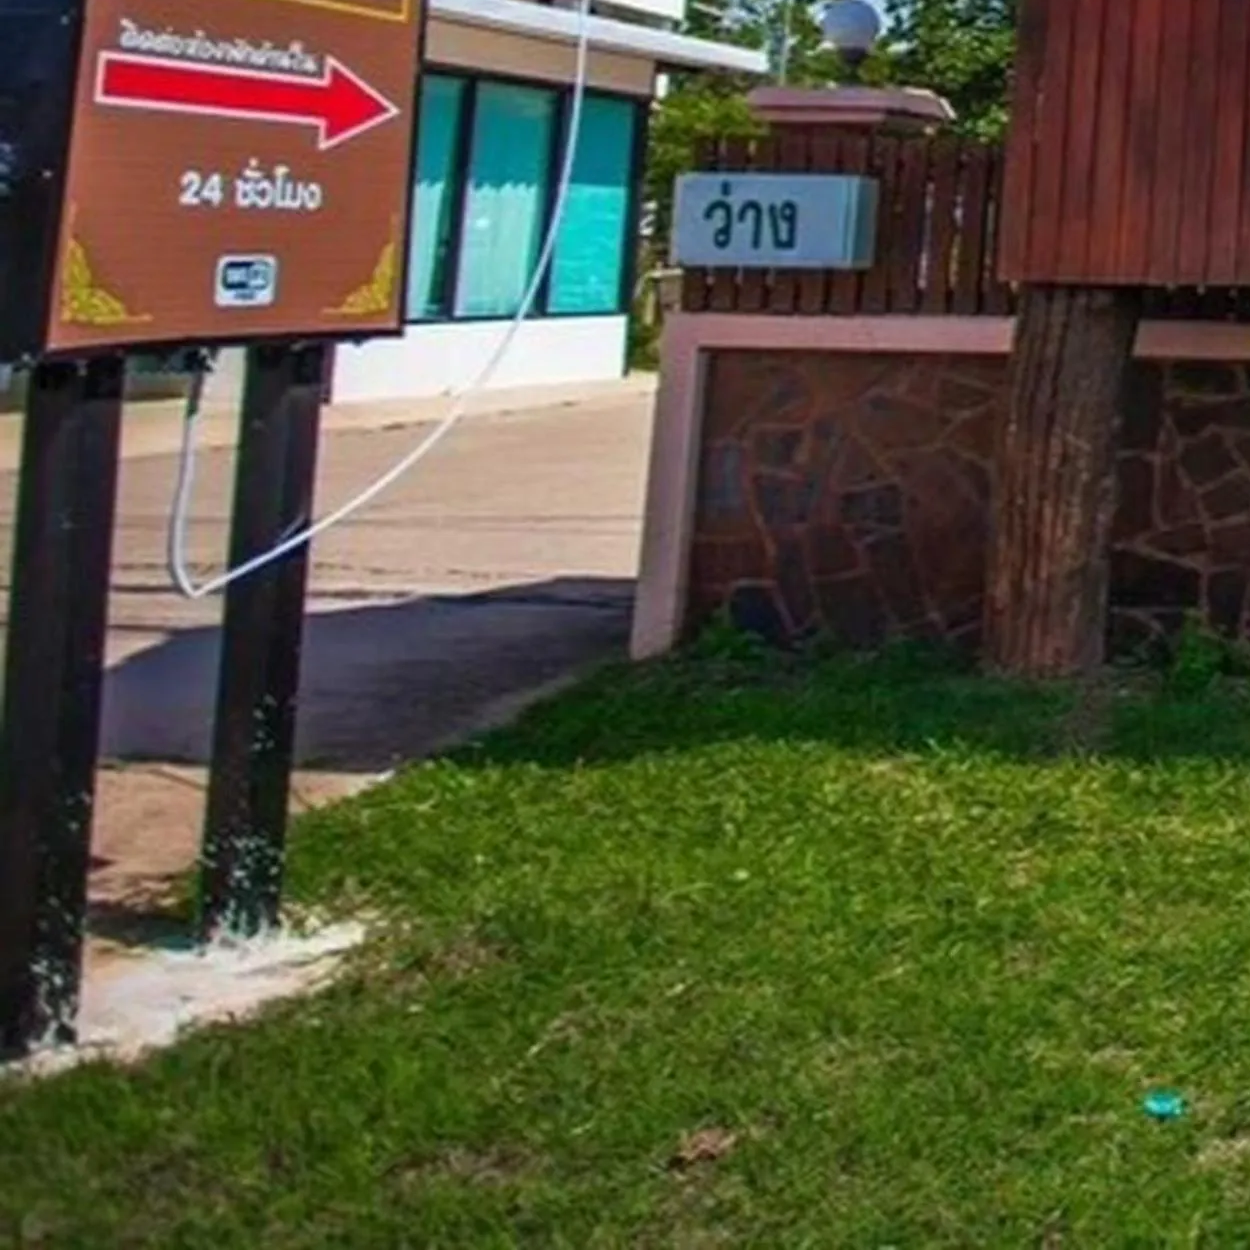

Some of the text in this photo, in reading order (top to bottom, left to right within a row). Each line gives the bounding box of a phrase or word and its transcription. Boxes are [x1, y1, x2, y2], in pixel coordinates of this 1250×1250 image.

[179, 156, 322, 210] 24 ชั่วโมง
[703, 180, 797, 250] ว่าง
